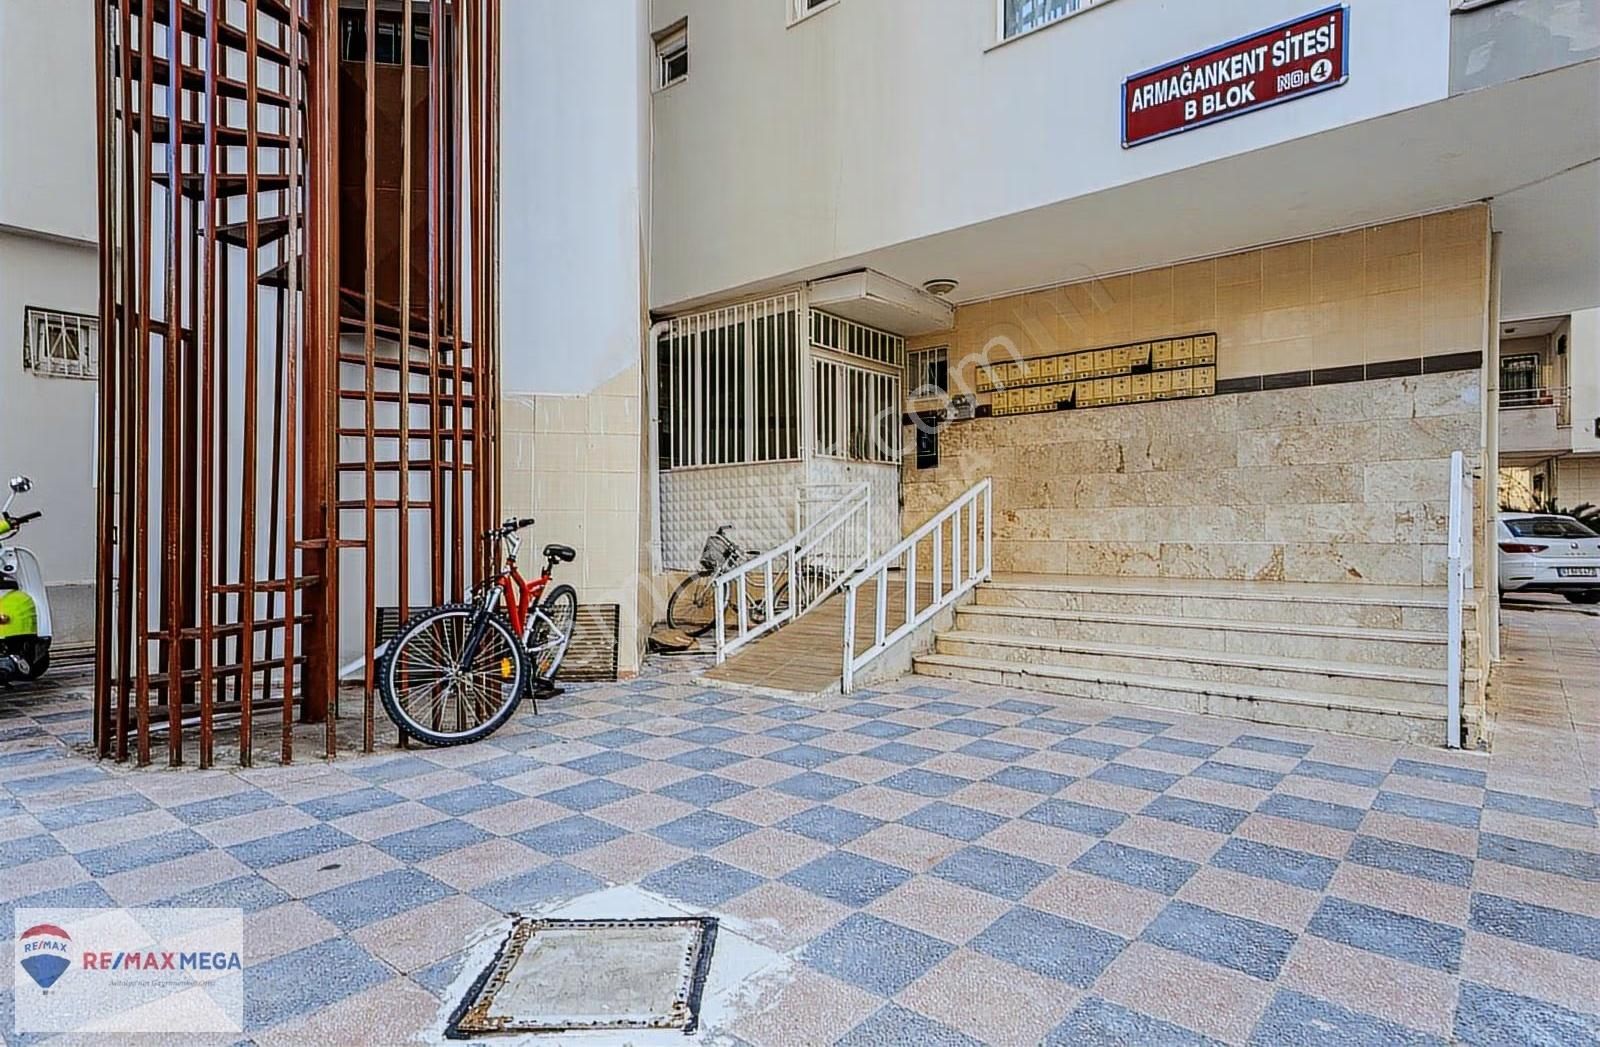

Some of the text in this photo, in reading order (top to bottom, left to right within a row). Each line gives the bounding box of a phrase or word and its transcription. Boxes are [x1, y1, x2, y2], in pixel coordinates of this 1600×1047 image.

[1131, 16, 1336, 113] ARMAĞANKENT SİTESİ
[1184, 81, 1256, 121] B BLOK
